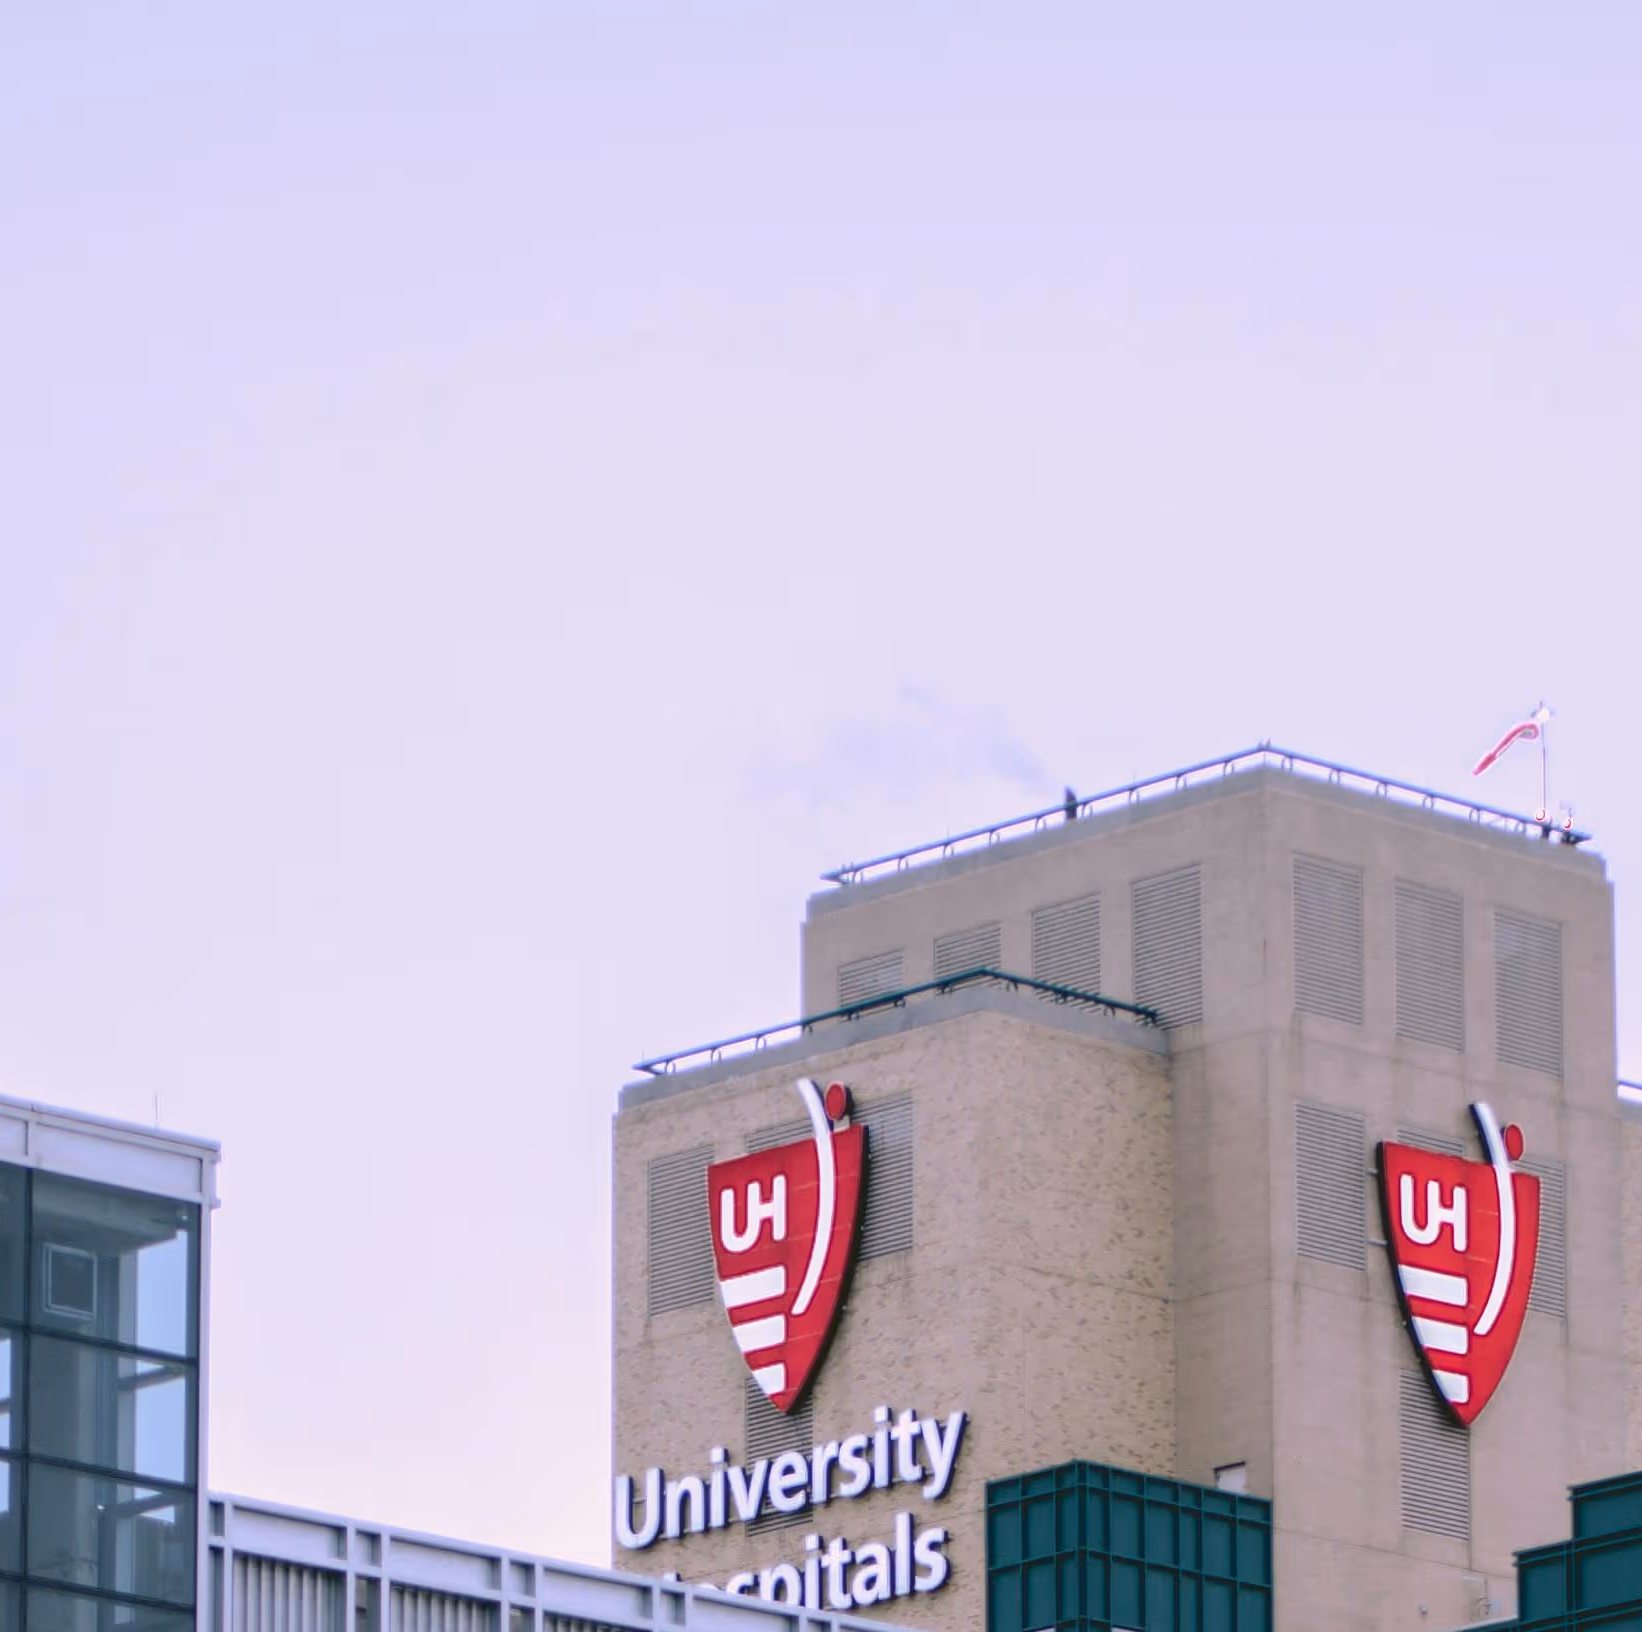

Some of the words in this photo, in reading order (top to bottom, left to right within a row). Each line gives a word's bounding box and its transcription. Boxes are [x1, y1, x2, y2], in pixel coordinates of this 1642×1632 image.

[721, 1174, 787, 1252] UH
[1400, 1174, 1467, 1252] UH
[614, 1405, 969, 1549] University
[663, 1510, 950, 1609] pitals
